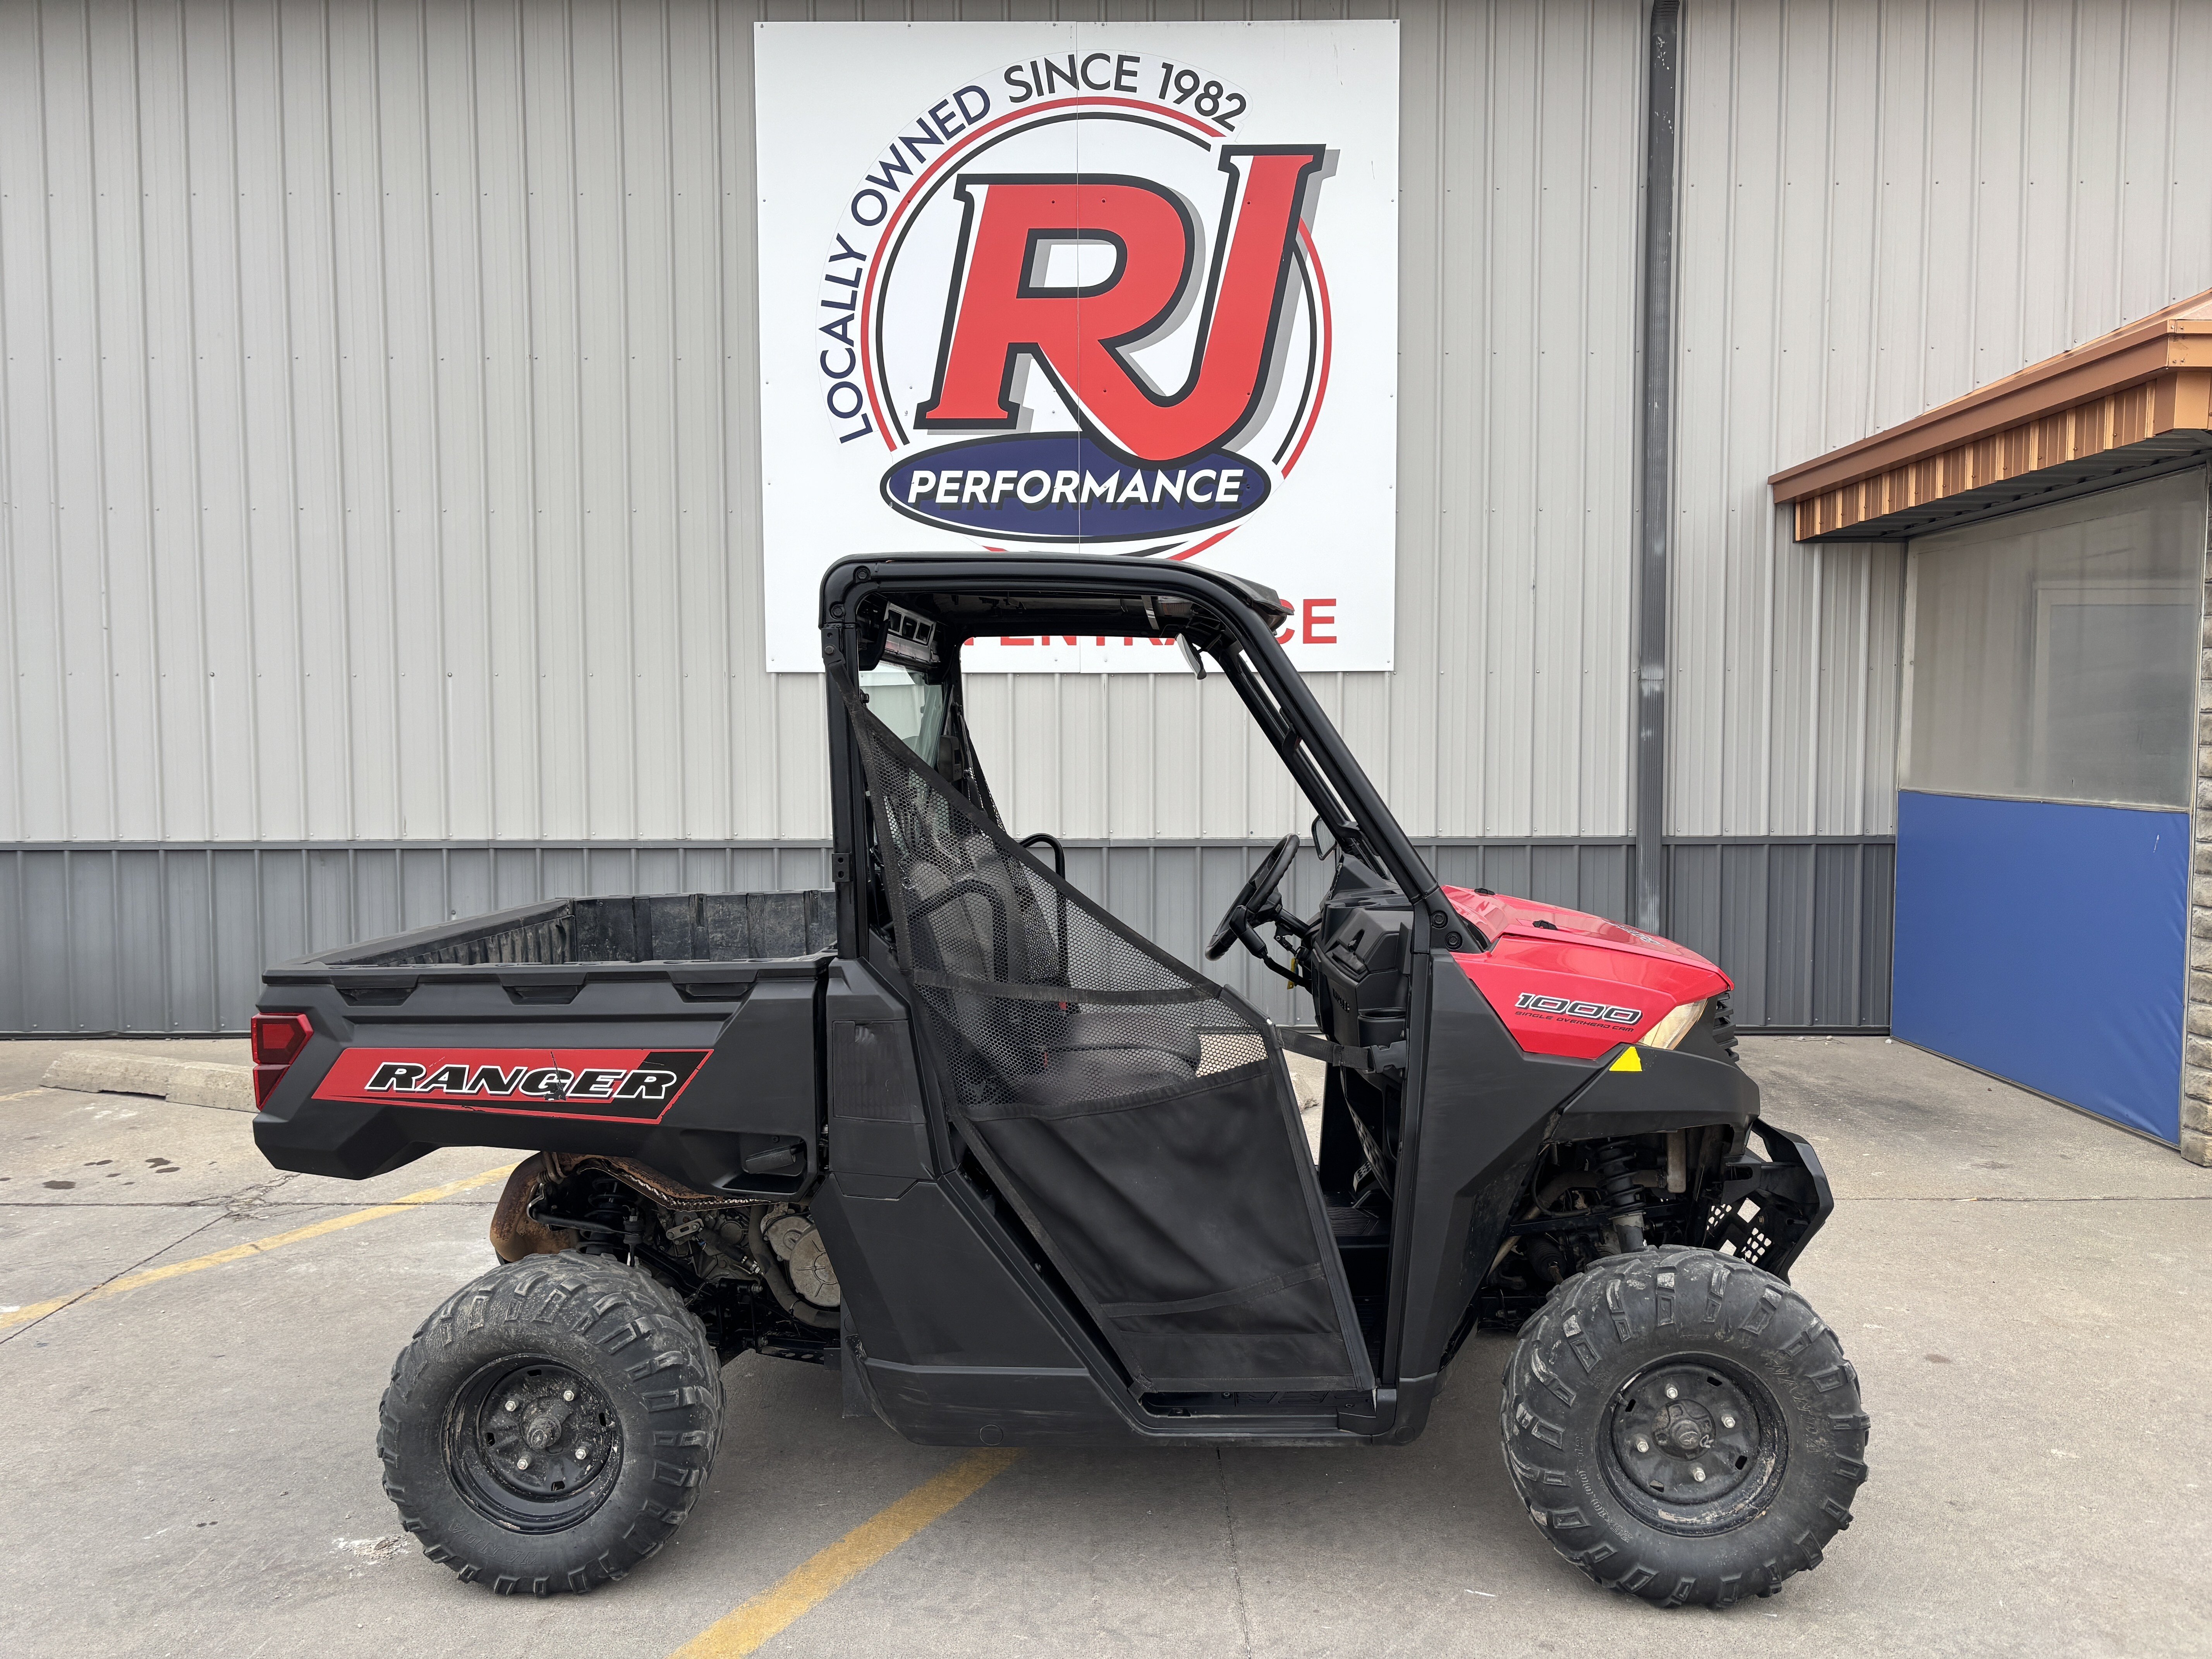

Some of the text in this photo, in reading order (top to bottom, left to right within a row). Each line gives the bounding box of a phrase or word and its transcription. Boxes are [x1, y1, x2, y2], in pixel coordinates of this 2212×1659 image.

[818, 53, 1246, 444] LOCALLY OWNED SINCE 1982
[913, 144, 1327, 469] RJ
[907, 469, 1244, 503] PERFORMANCE
[1514, 1011, 1554, 1020] SINGLE
[1556, 1017, 1611, 1029] OVERHEAD
[1515, 992, 1643, 1026] 1000
[364, 1061, 677, 1100] RANGER
[447, 1518, 542, 1566] WANDA
